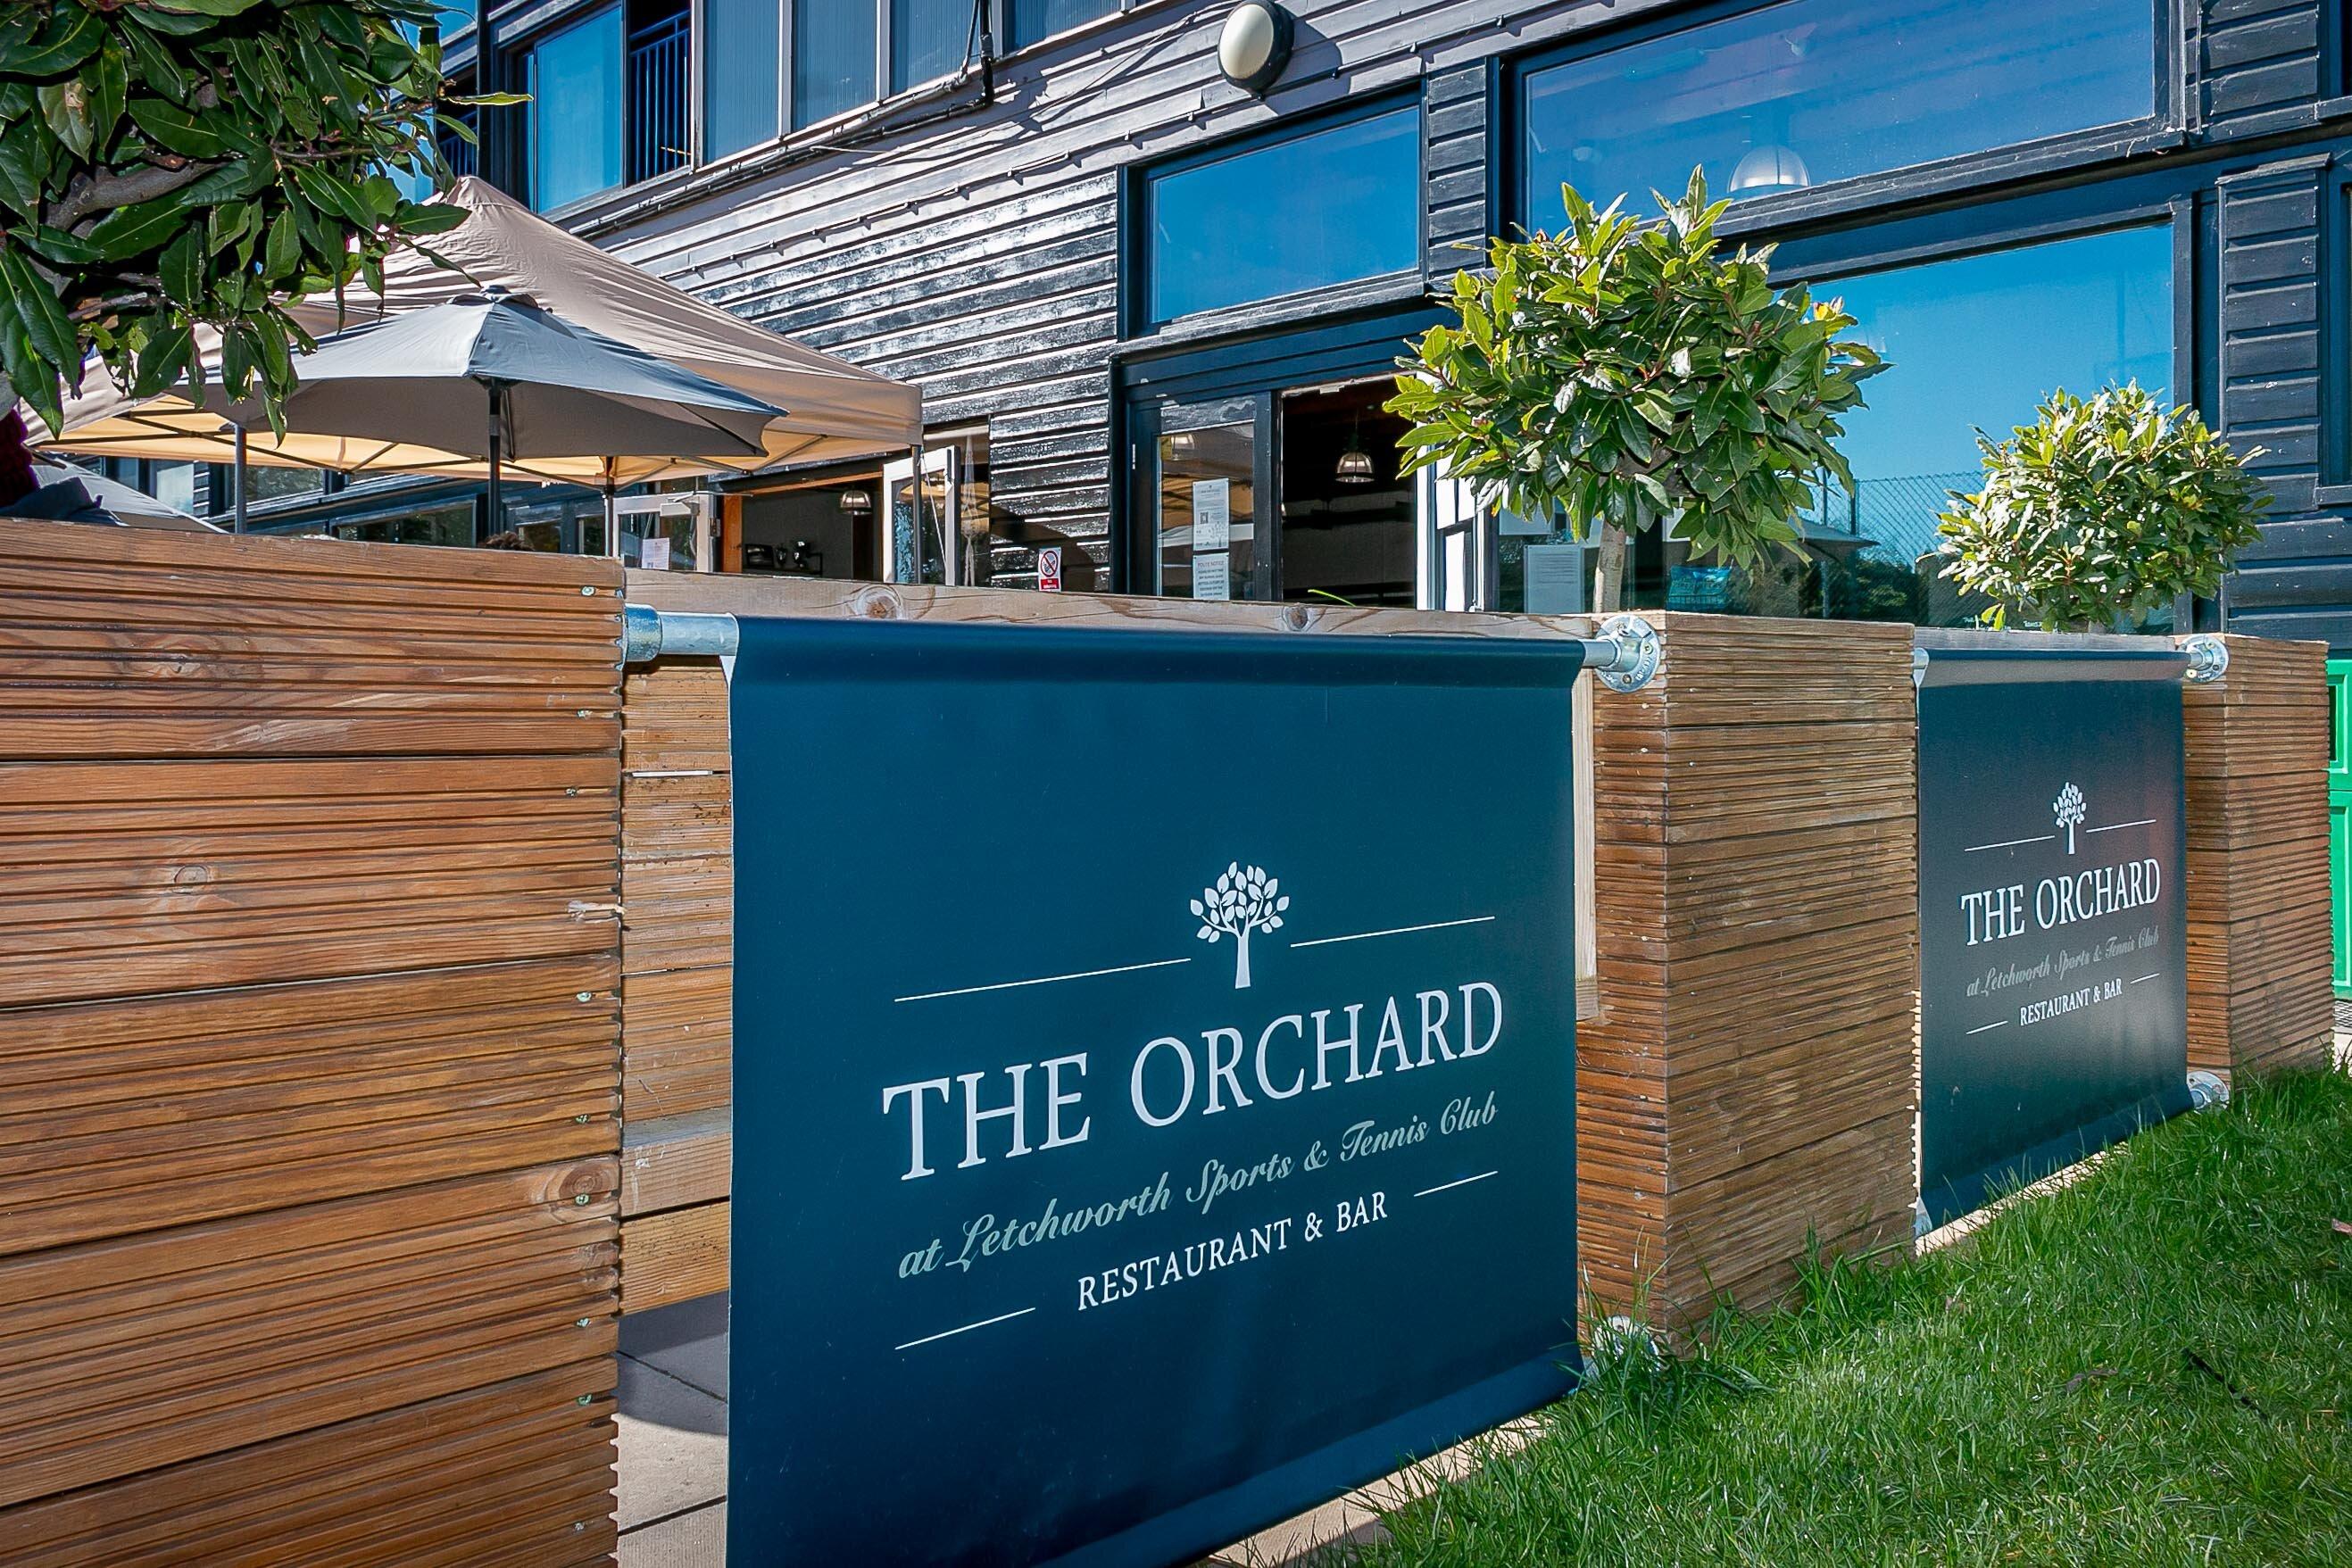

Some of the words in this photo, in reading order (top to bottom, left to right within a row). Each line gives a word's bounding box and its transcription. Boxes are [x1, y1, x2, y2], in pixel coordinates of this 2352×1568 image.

[1960, 884, 2025, 946] THE
[2036, 858, 2161, 929] ORCHARD
[1966, 977, 1981, 997] at
[1981, 954, 2051, 998] Letchworth
[2055, 949, 2091, 980] Sports
[2092, 944, 2102, 962] &
[2105, 935, 2136, 960] Tennis
[2139, 925, 2160, 950] Club
[2020, 988, 2091, 1026] RESTAURANT
[2092, 984, 2101, 1004] &
[2104, 978, 2123, 1001] BAR
[882, 1051, 1091, 1181] THE
[1130, 982, 1503, 1127] ORCHARD
[898, 1238, 943, 1279] at
[943, 1171, 1174, 1273] Letchworth
[1184, 1154, 1292, 1215] Sports
[1303, 1141, 1330, 1172] &
[1340, 1120, 1428, 1162] Tennis
[1439, 1091, 1499, 1136] Club
[1077, 1217, 1292, 1311] RESTAURANT
[1304, 1212, 1324, 1242] &
[1335, 1191, 1388, 1232] BAR
